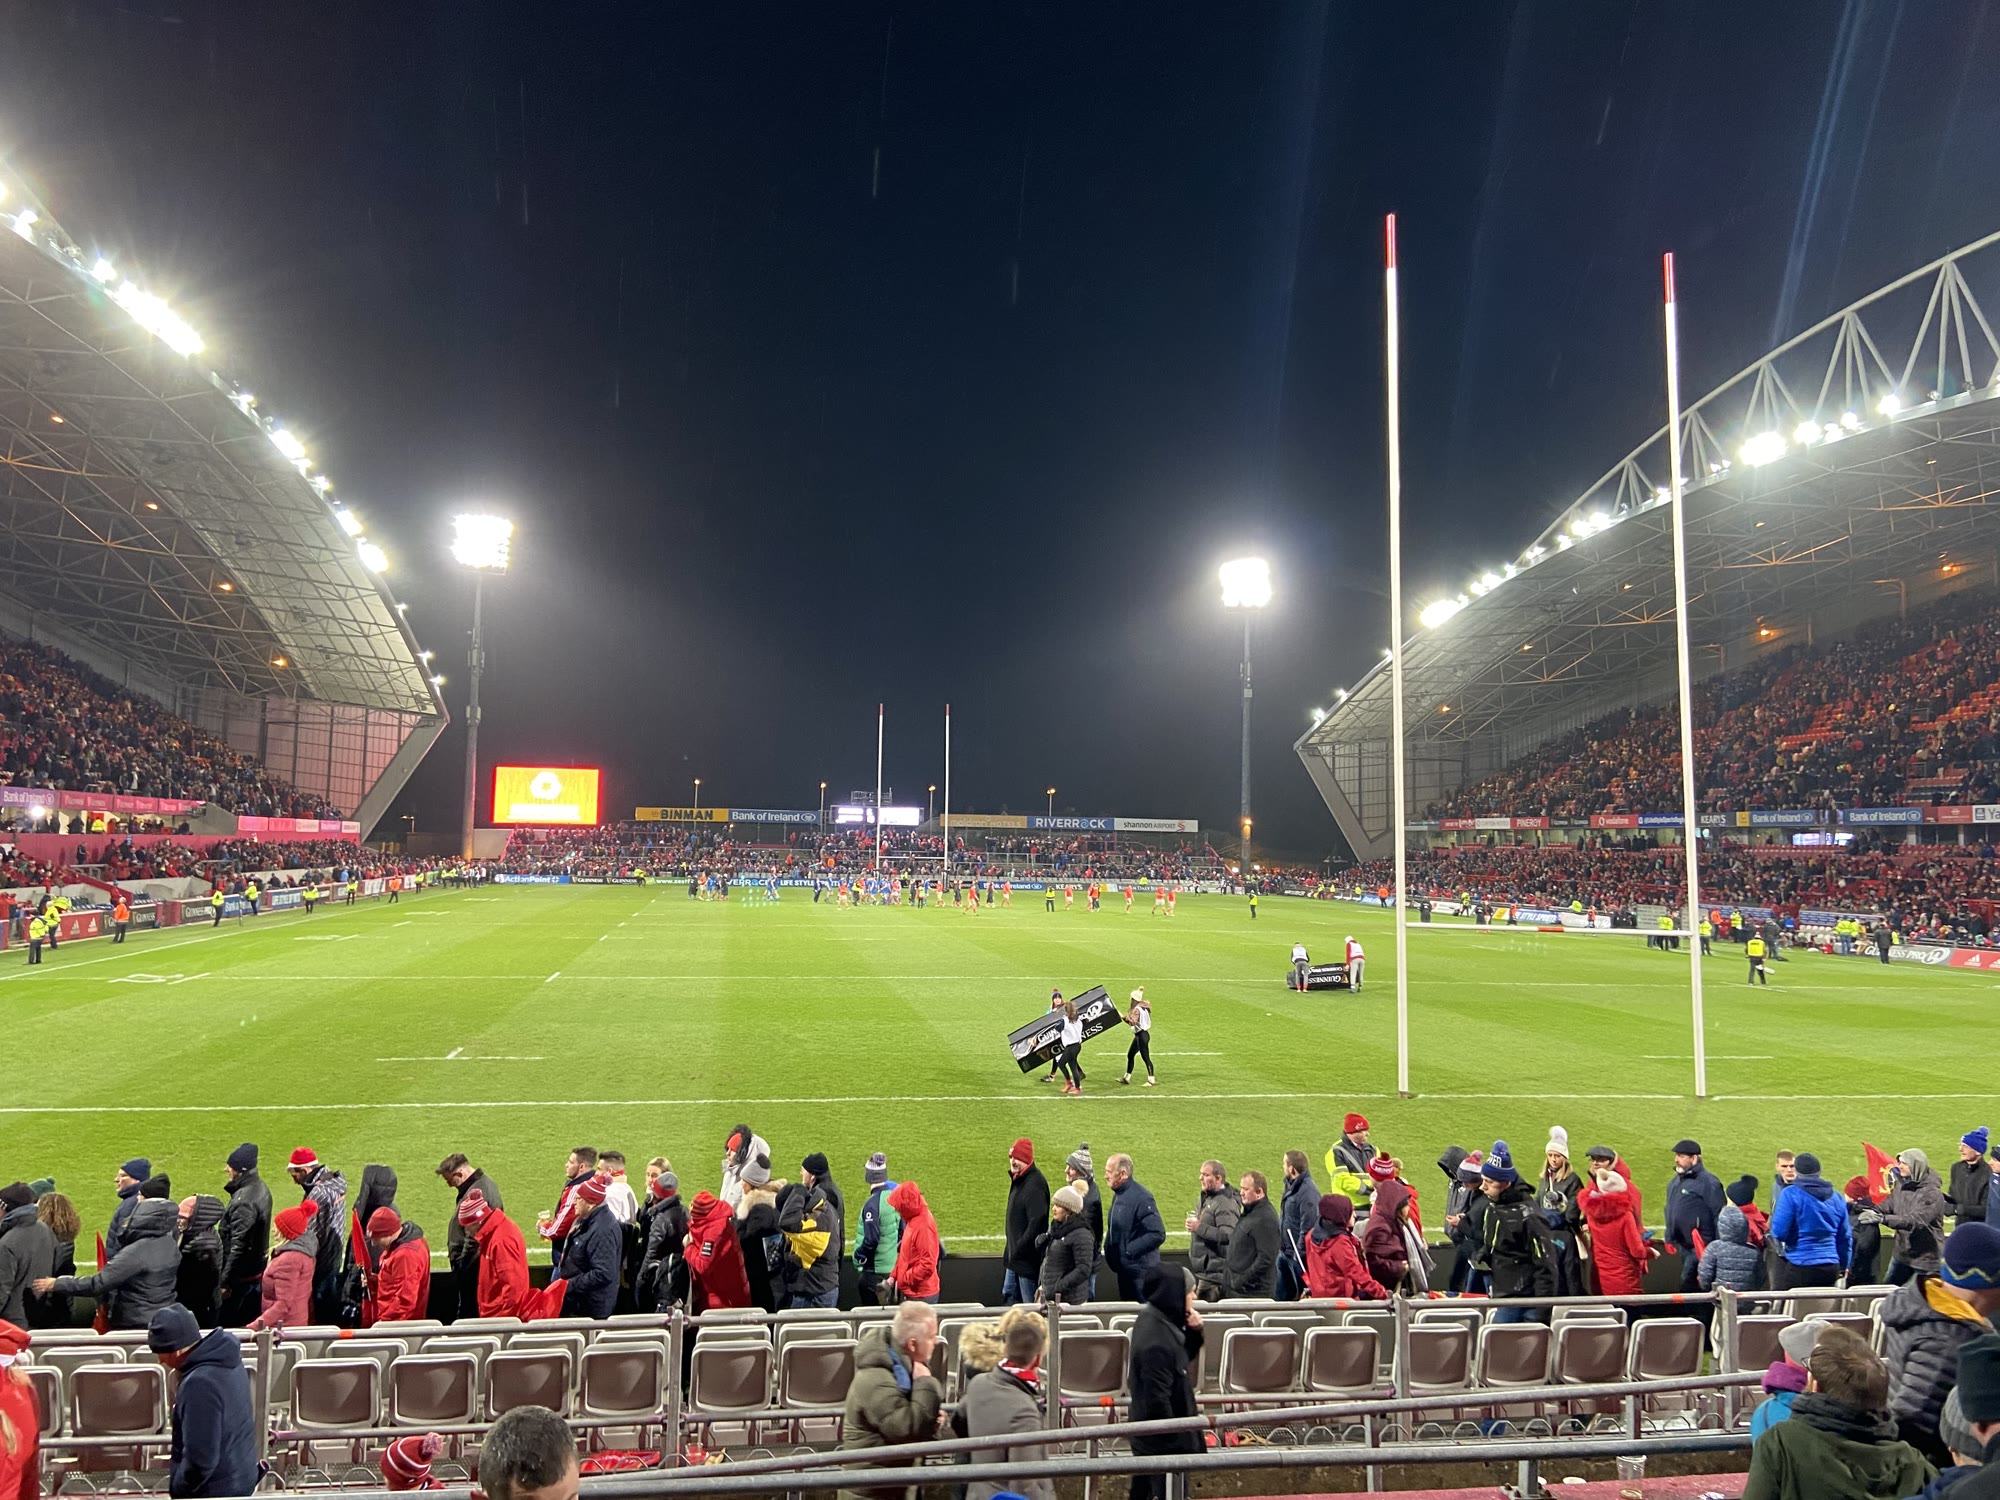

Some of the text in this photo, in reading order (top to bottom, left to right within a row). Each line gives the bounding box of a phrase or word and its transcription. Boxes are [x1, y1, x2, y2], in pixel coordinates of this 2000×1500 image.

[661, 809, 714, 820] BINMAN
[732, 811, 800, 822] Bank of Ireland
[1752, 813, 1801, 823] Bank of Ireland
[1849, 811, 1906, 821] Bank of Ireland
[1035, 817, 1106, 829] RIVERROCK
[1123, 821, 1153, 829] shannon
[1516, 818, 1542, 827] PINERGY
[504, 875, 551, 884] ActionPoint
